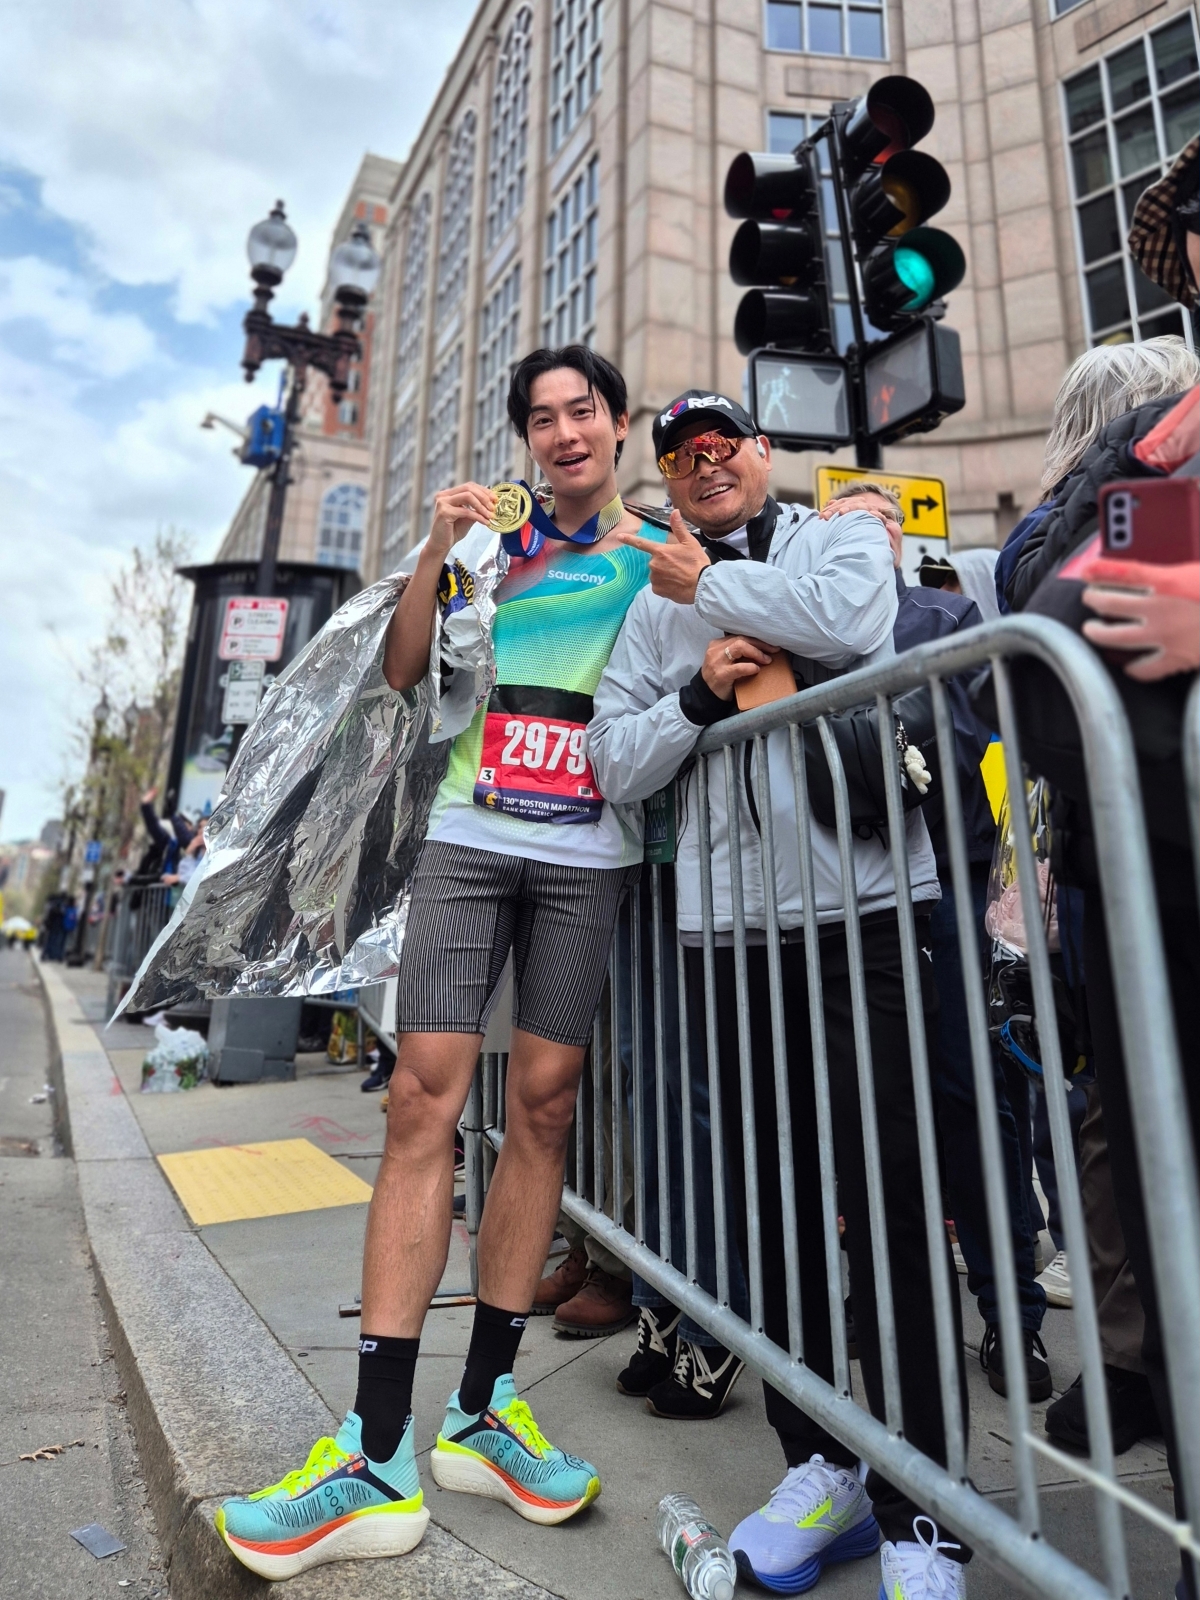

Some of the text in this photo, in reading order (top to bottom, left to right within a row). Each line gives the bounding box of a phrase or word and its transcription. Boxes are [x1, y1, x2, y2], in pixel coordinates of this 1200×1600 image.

[660, 395, 733, 428] KOREA
[547, 569, 606, 585] saucony
[501, 720, 587, 775] 2979
[482, 769, 492, 781] 3
[519, 798, 550, 810] BOSTON
[550, 802, 590, 813] MARATHON
